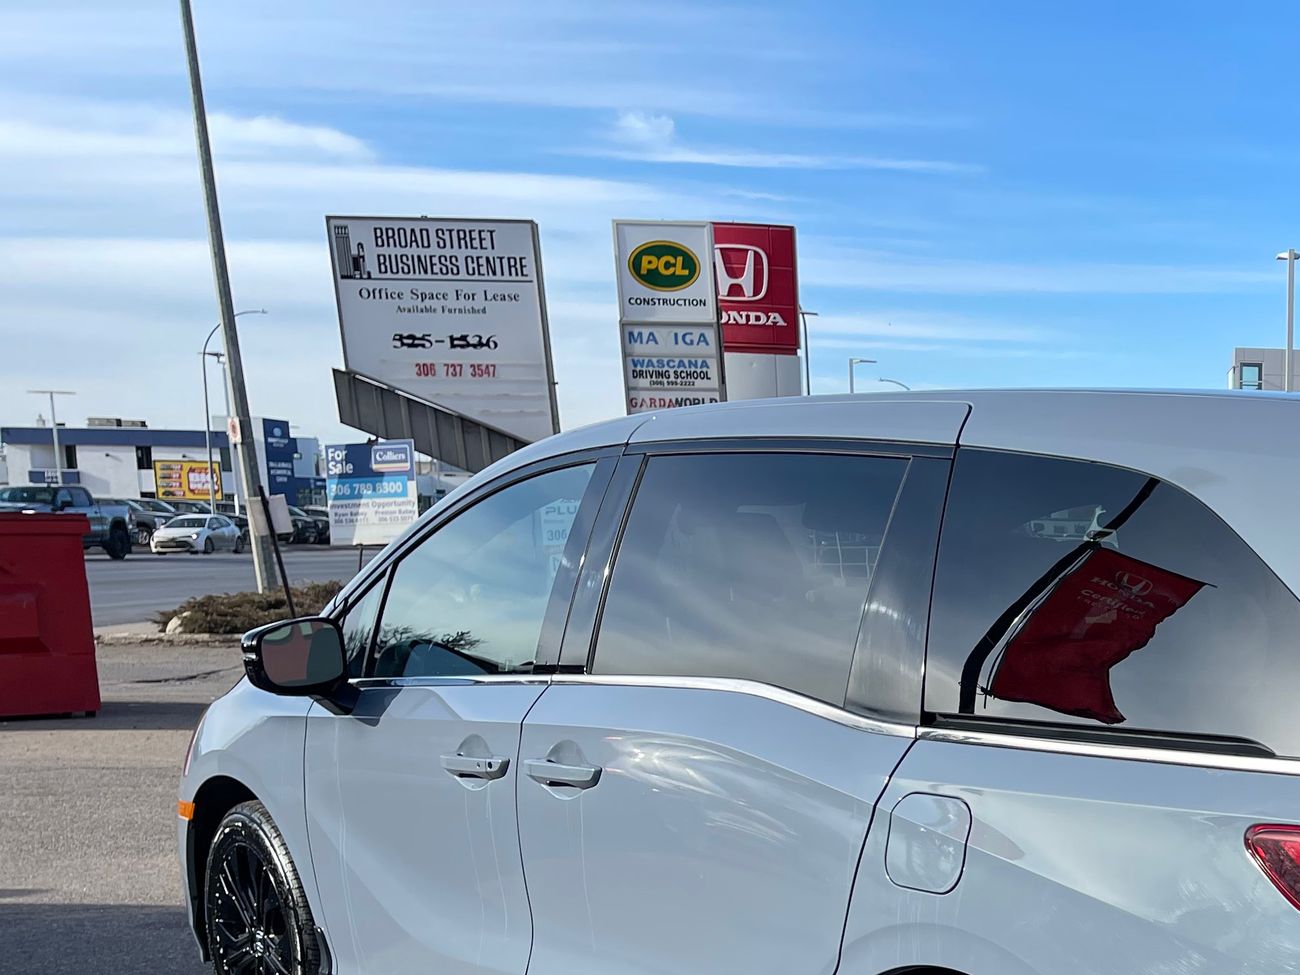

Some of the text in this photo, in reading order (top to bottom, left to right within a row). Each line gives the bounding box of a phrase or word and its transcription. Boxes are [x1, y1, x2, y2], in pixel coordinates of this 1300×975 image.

[373, 227, 496, 250] BROAD STREET
[376, 253, 529, 278] BUSINESS CENTRE
[640, 254, 689, 276] PCL
[358, 287, 520, 302] Office Space For Lease
[628, 297, 706, 307] CONSTRUCTION
[396, 304, 487, 315] Available Furnished
[631, 358, 711, 369] WASCANA
[415, 363, 497, 378] 306 737 3547
[631, 369, 712, 380] DRIVING SCHOOL
[328, 449, 347, 461] For
[376, 451, 405, 461] Colliers
[328, 461, 354, 475] Sale
[330, 484, 350, 496] 306
[371, 500, 415, 509] Opportunity
